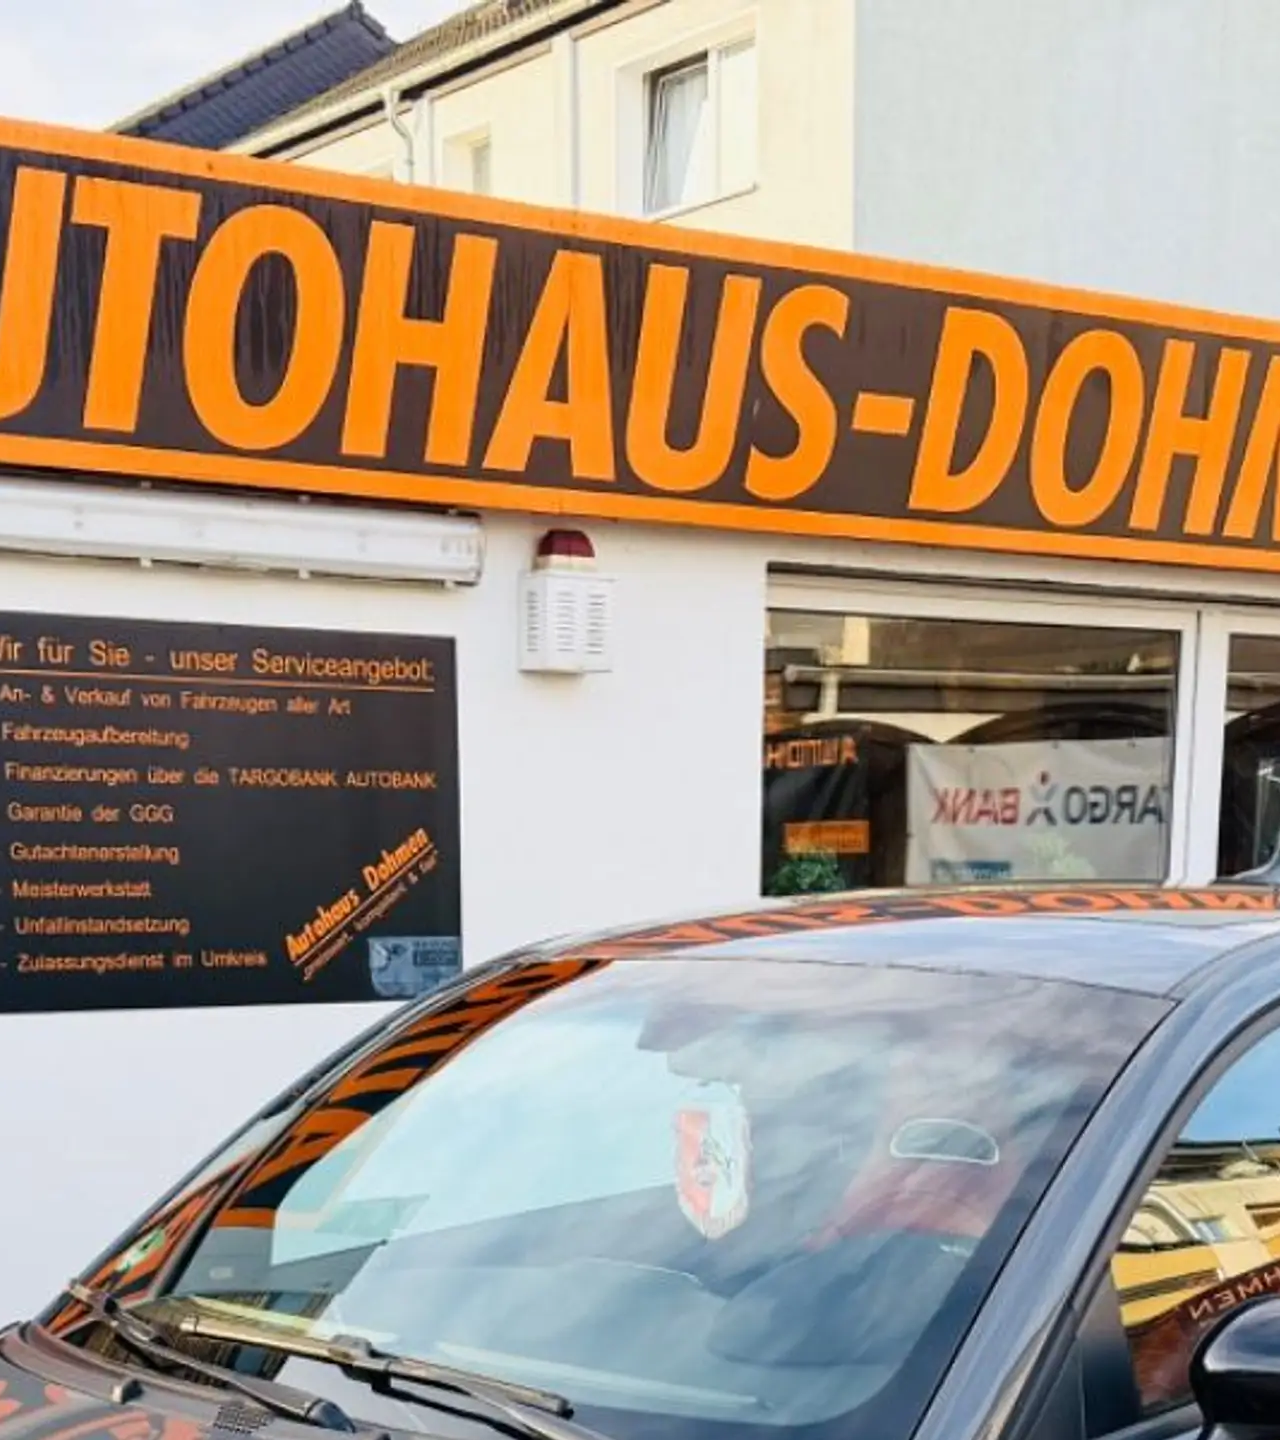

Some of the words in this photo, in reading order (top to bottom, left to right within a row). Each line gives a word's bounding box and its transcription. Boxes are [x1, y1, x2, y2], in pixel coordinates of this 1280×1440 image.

[37, 636, 74, 664] für
[88, 640, 131, 667] Sie
[170, 650, 238, 672] unser
[41, 685, 55, 704] &
[64, 686, 131, 707] Verkauf
[140, 693, 171, 709] von
[180, 691, 277, 714] Fahrzeugen
[328, 698, 351, 715] Art
[1, 721, 189, 749] Fahrzeugaufbereitung
[5, 761, 137, 787] Finanzierungen
[148, 765, 183, 785] über
[194, 767, 219, 785] die
[229, 768, 336, 787] TARGOBANK
[347, 770, 437, 789] AUTOBANK
[7, 801, 82, 822] Garantie
[91, 805, 119, 822] der
[129, 804, 173, 823] GGG
[10, 841, 180, 865] Gutachtenerstellung
[12, 879, 151, 899] Meisterwerkstatt
[285, 888, 361, 962] Autohaus
[362, 827, 429, 892] Dohmen
[14, 915, 190, 937] Unfallinstandsetzung
[17, 951, 164, 974] Zulassungsdienst
[173, 953, 192, 967] im
[201, 949, 267, 967] Umkreis
